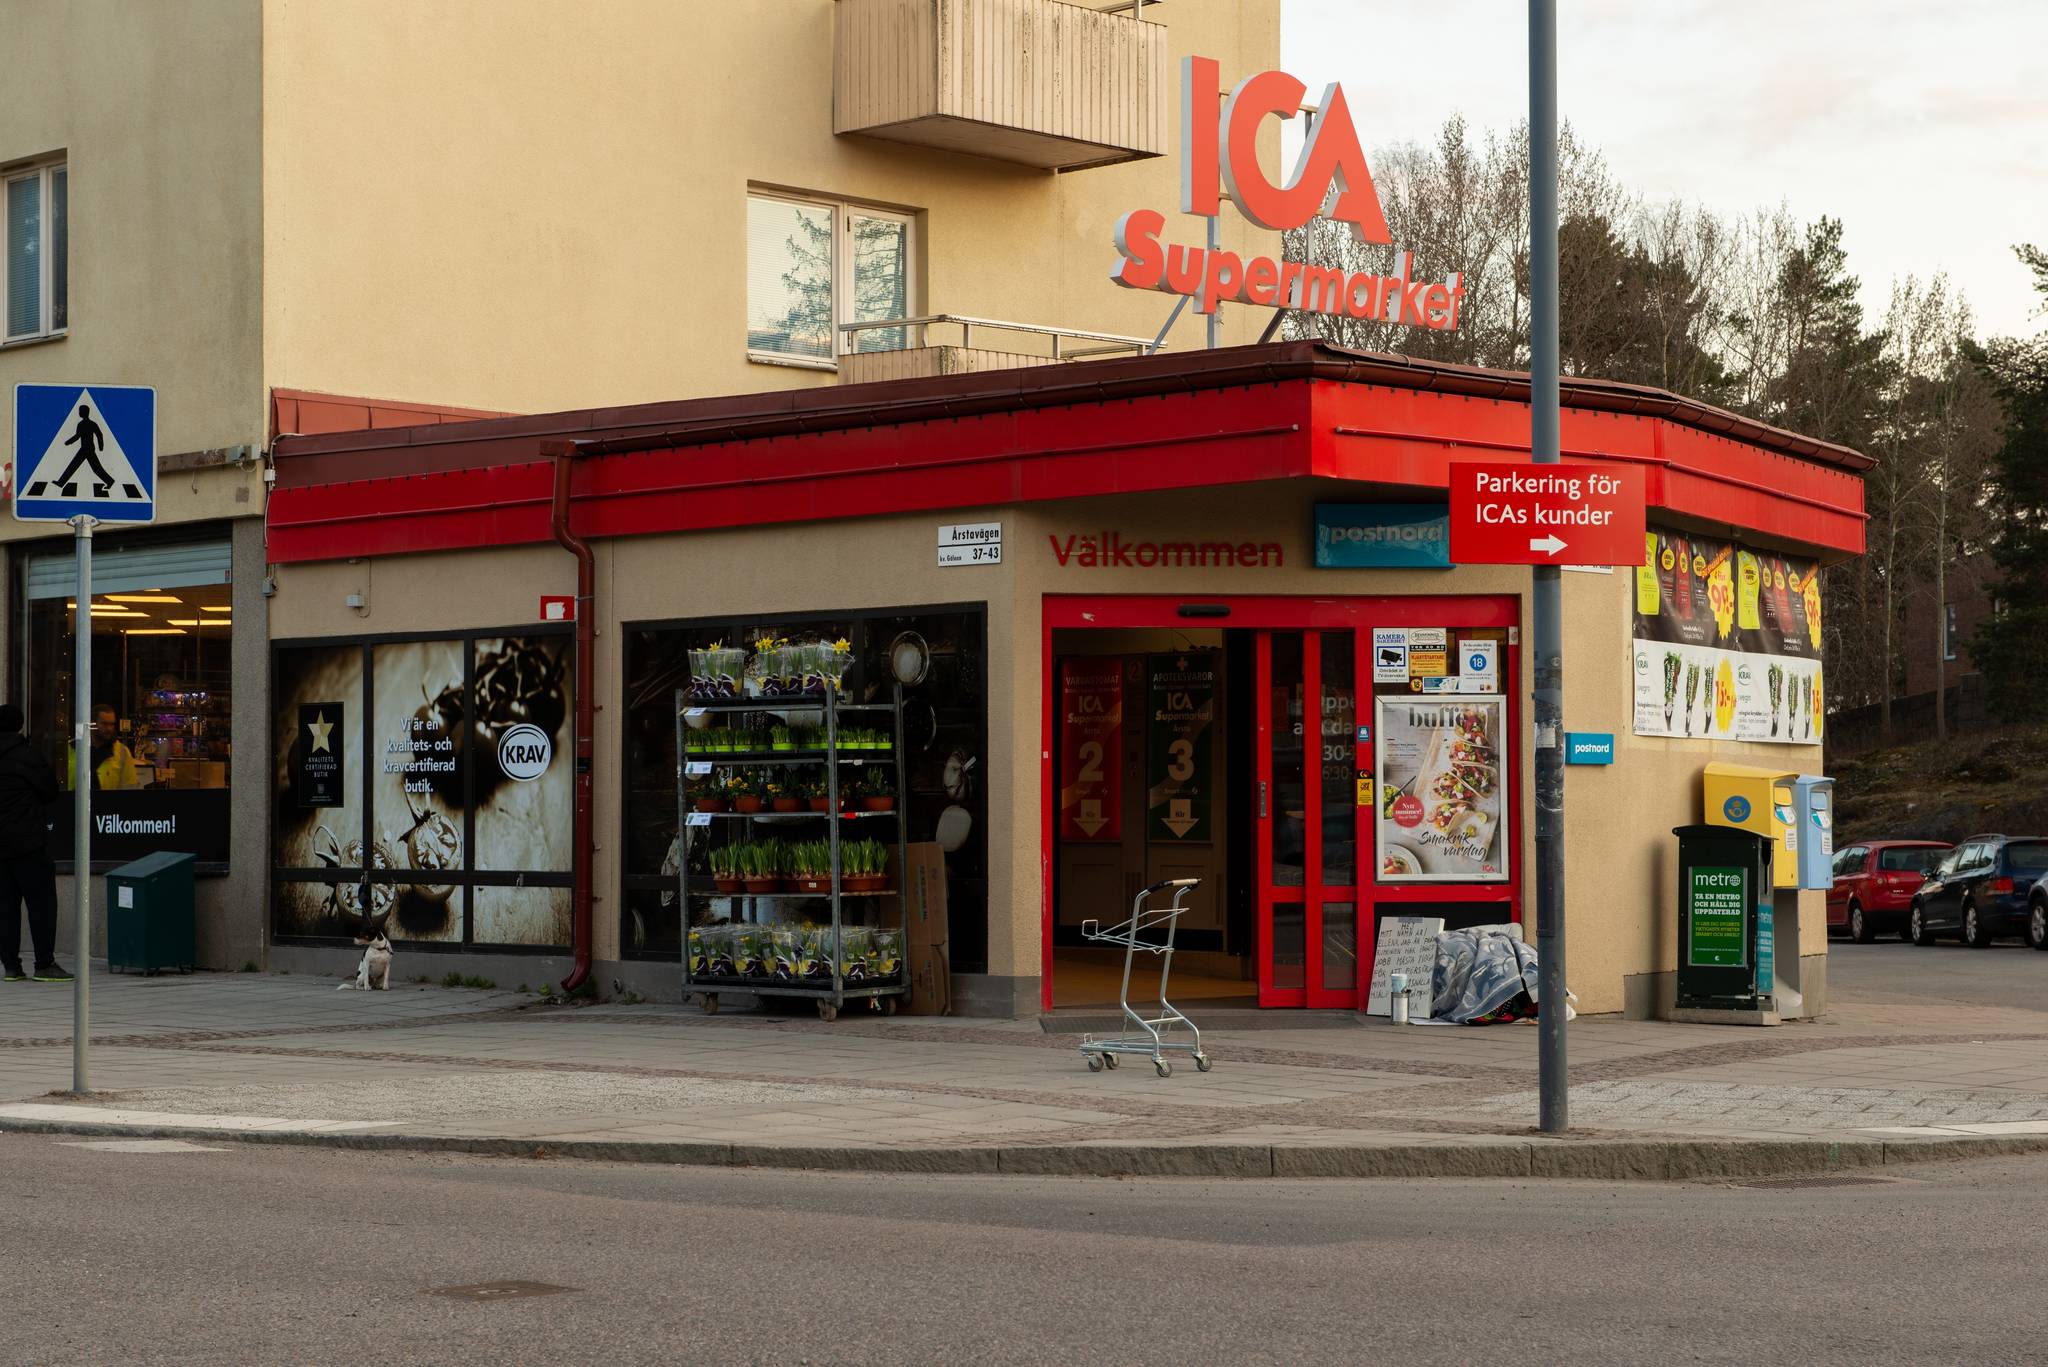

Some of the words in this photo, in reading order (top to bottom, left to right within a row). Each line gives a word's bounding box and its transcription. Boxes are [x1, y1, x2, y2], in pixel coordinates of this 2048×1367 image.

[1181, 55, 1392, 245] ICA
[1110, 208, 1465, 331] Supermarket
[1475, 472, 1581, 500] Parkering
[1587, 474, 1621, 495] för
[1476, 503, 1528, 524] ICAs
[1534, 504, 1613, 525] kunder
[952, 526, 999, 542] Årstavägen
[1331, 523, 1443, 545] postnord
[972, 546, 999, 560] 37-43
[1049, 531, 1284, 568] Välkommen
[1472, 657, 1483, 668] 18
[1078, 695, 1105, 713] ICA
[1167, 691, 1194, 712] ICA
[1066, 712, 1119, 726] Supermarket
[1154, 709, 1210, 723] Supermarket
[400, 718, 411, 731] Vi
[412, 718, 424, 730] är
[426, 720, 439, 730] en
[386, 737, 432, 753] kvalitets-
[434, 736, 452, 751] och
[1575, 743, 1610, 755] postnord
[505, 745, 546, 764] KRAV
[1078, 740, 1105, 782] 2
[1167, 738, 1195, 782] 3
[383, 757, 456, 773] kravcertifierad
[405, 778, 434, 793] butik.
[96, 814, 176, 834] Välkommen!
[1417, 831, 1471, 846] Smakrik
[1443, 843, 1488, 861] vardag
[1695, 873, 1741, 887] metro
[1710, 900, 1728, 908] HÅLL
[1716, 893, 1741, 901] METRO
[1694, 908, 1741, 916] UPPDATERAD
